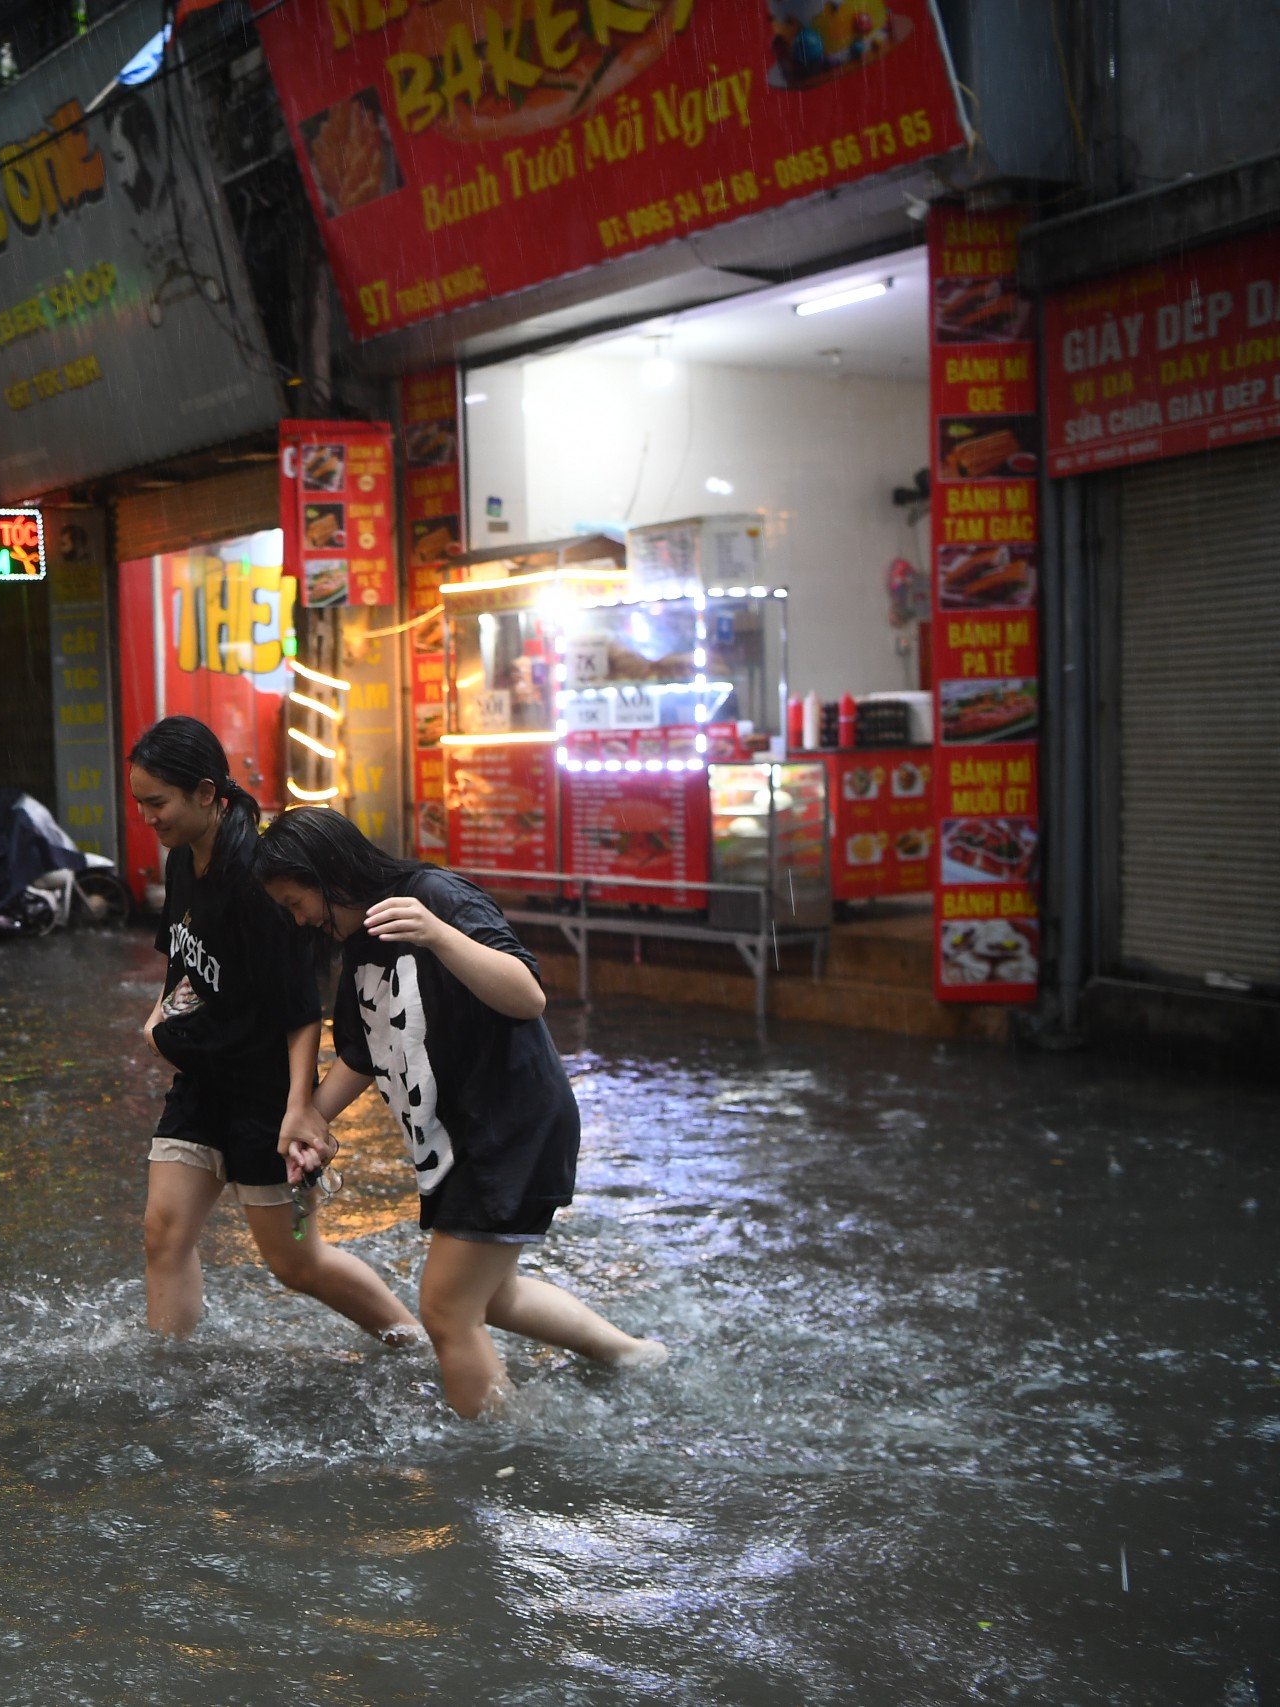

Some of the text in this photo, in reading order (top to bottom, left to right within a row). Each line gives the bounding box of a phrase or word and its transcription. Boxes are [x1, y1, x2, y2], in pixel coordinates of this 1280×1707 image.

[421, 62, 753, 232] Bánh Tươi Mỗi Ngày
[862, 121, 897, 160] 73
[899, 107, 933, 148] 85
[49, 262, 117, 320] SHOP
[359, 279, 392, 326] 97
[1247, 279, 1280, 329] D
[172, 555, 283, 675] THE
[961, 651, 988, 677] PA
[943, 889, 996, 918] BÁNH
